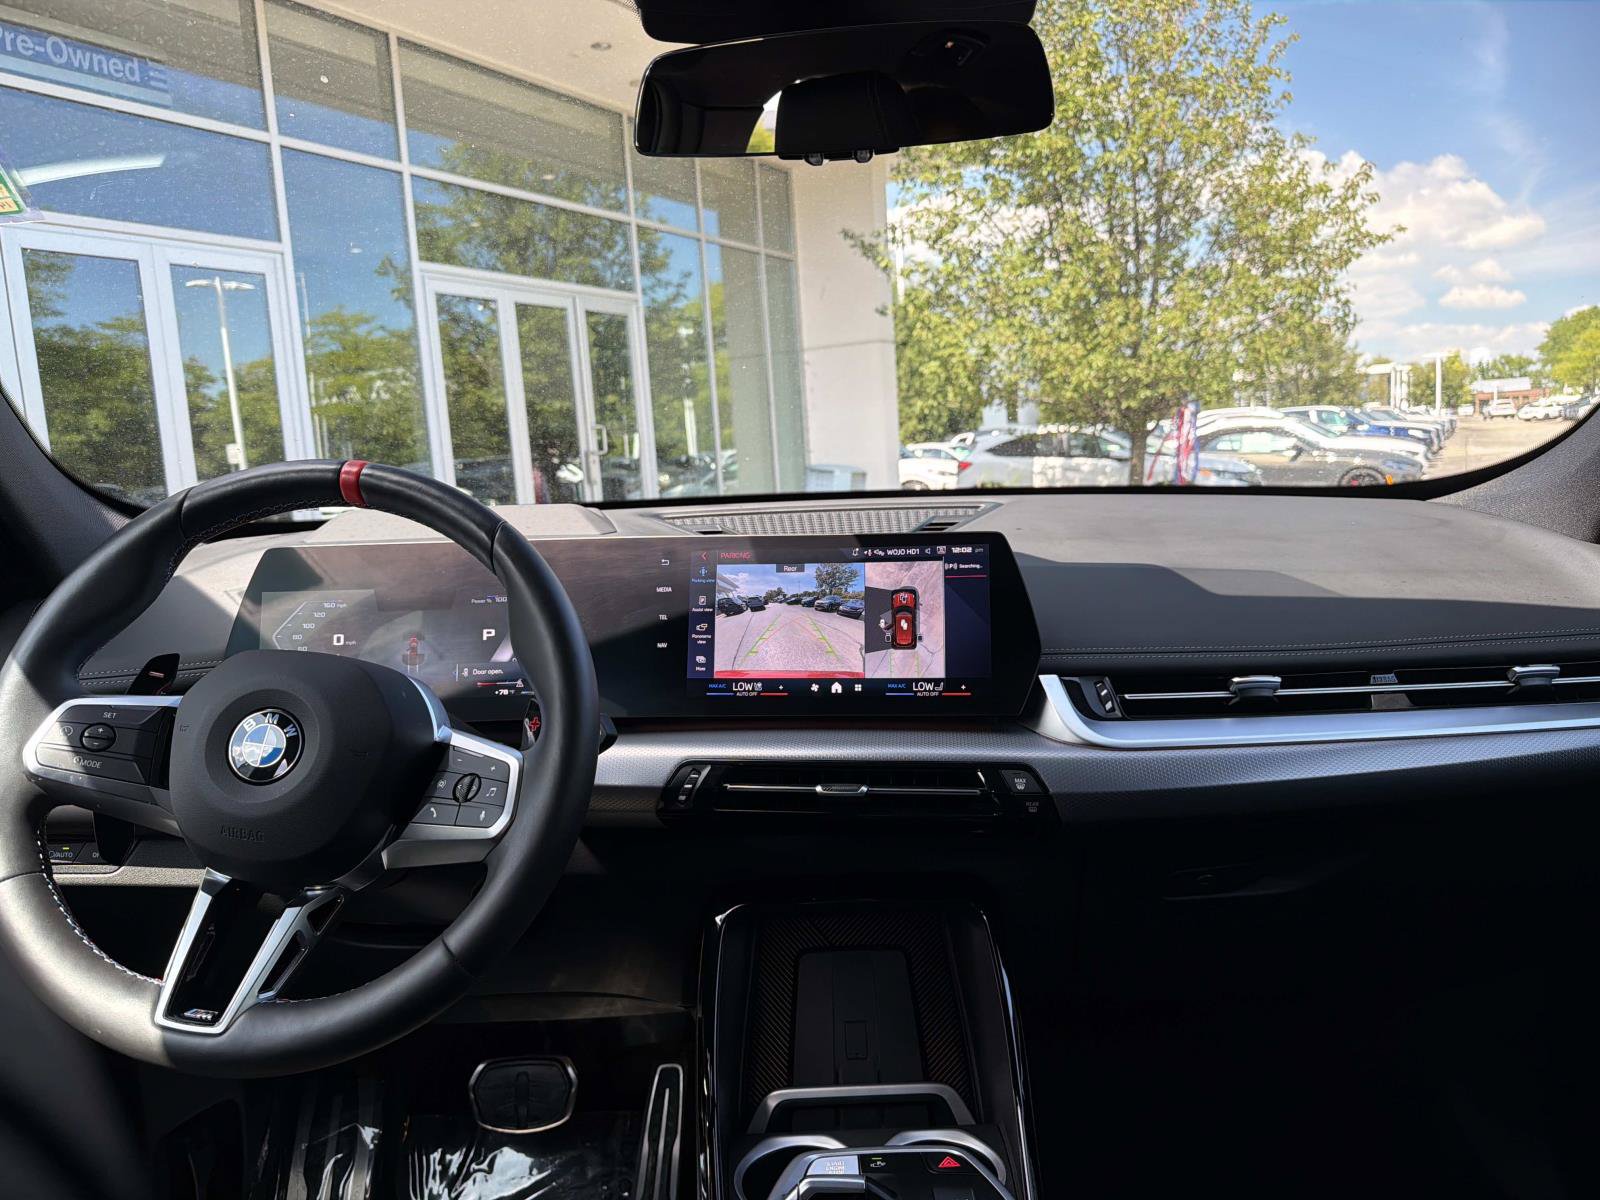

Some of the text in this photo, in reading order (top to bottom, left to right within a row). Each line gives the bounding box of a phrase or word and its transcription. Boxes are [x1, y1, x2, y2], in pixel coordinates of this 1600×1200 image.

[333, 633, 344, 646] 0
[482, 628, 496, 641] P
[732, 682, 753, 691] LOW
[912, 681, 934, 691] LOW
[103, 711, 117, 720] SET
[243, 712, 298, 738] BMW
[79, 759, 103, 769] MODE
[220, 825, 265, 842] AIRBAG
